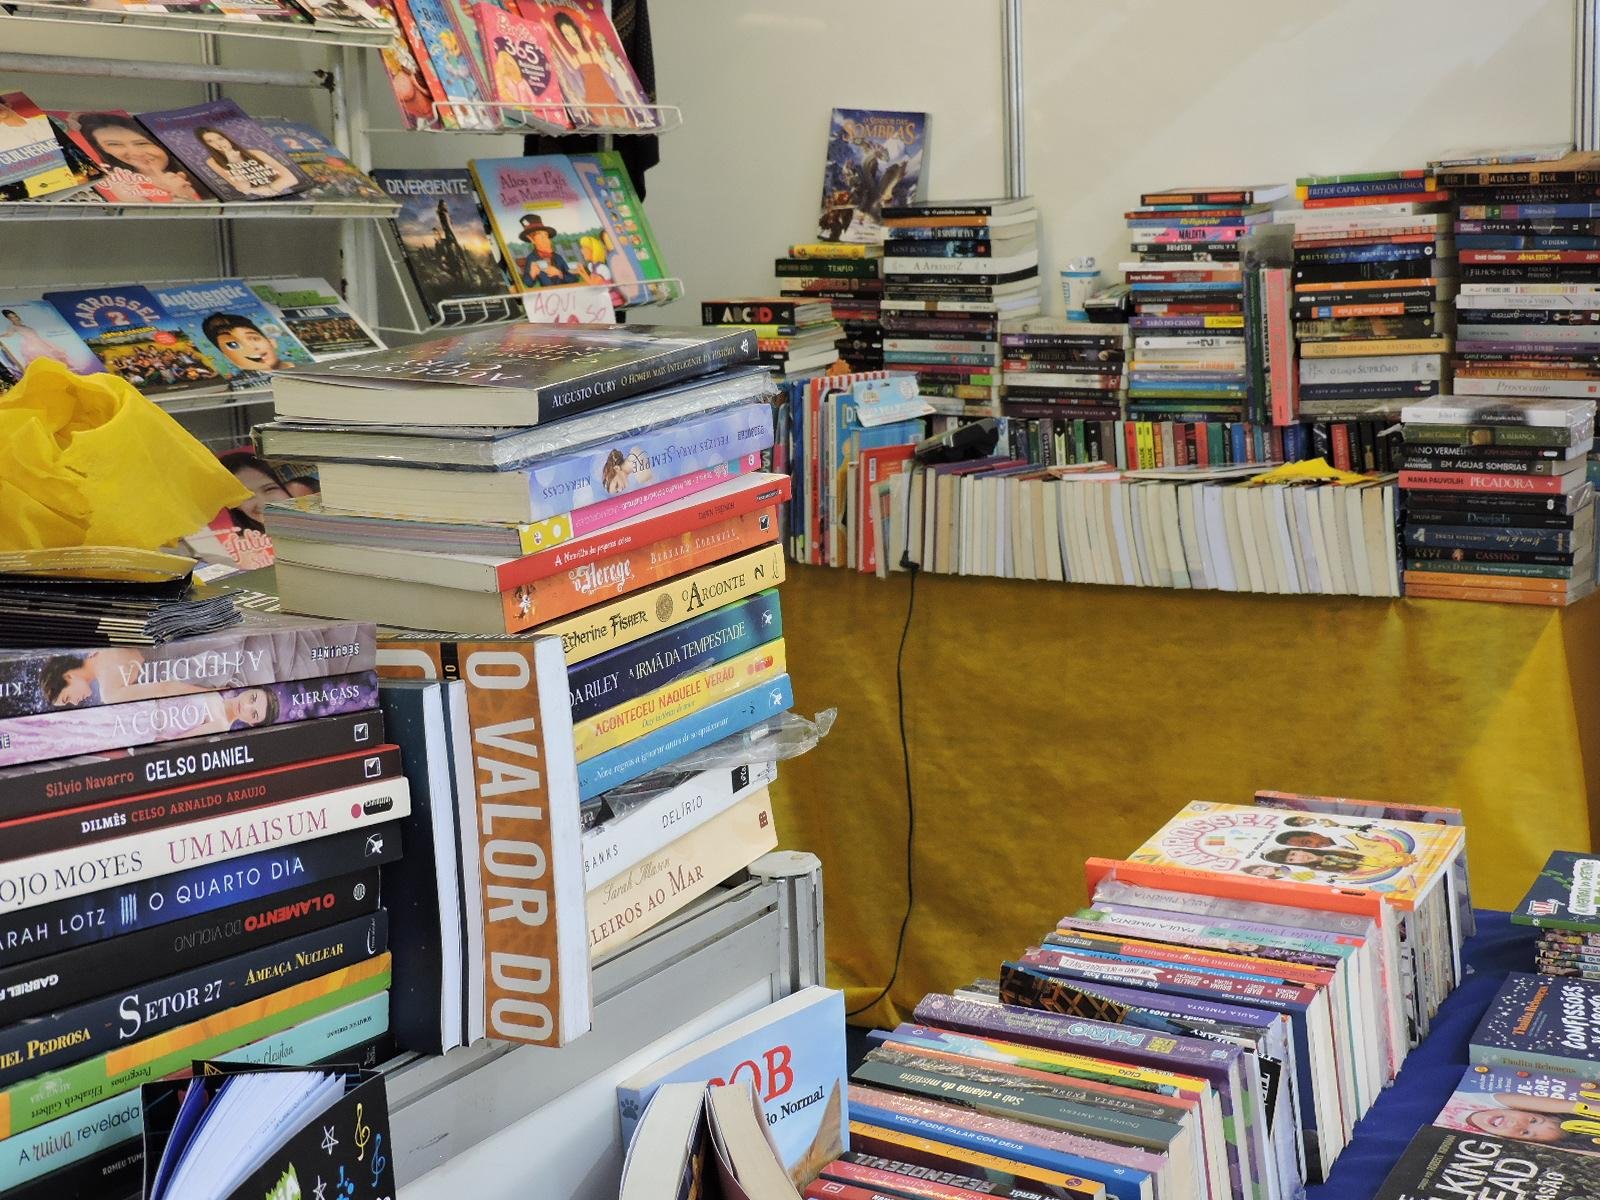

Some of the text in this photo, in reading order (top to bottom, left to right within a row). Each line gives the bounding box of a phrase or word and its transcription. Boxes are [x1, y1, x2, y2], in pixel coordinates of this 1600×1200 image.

[842, 117, 917, 146] SOMBRAS
[385, 178, 470, 197] DIVERGENTE
[1178, 229, 1206, 239] MALDITA
[80, 294, 161, 330] CARROSSEL
[108, 311, 130, 327] 2
[534, 291, 577, 316] AQUI
[551, 387, 592, 409] AUGUSTO
[593, 379, 617, 397] CURY
[631, 443, 678, 474] SEMPRE
[676, 443, 698, 459] PARA
[699, 434, 730, 453] FELIZES
[1456, 459, 1484, 470] ÁGUAS
[1486, 461, 1527, 472] SOMBRIAS
[1470, 476, 1535, 489] PECADORA
[608, 606, 649, 638] FISHER
[686, 574, 746, 613] ARCONTE
[584, 674, 621, 702] RILEY
[635, 651, 664, 680] IRMÃ
[680, 621, 746, 659] TEMPESTADE
[594, 665, 736, 738] ACONTECEU NAQUELE VERÃO
[129, 702, 215, 737] COROA
[45, 744, 255, 799] Silvio Navarro CELSO DANIEL
[80, 784, 267, 835] DILMÊS CELSO ARNALDO ARAUJO
[472, 717, 550, 929] VALOR
[661, 794, 704, 829] DELÍRIO
[53, 807, 329, 893] MOYES UM MAIS UM
[584, 843, 620, 874] BANKS
[59, 855, 306, 936] LOTZ O QUARTO DIA
[588, 863, 705, 948] LEIROS AO MAR
[243, 895, 323, 933] LAMENTO
[1109, 914, 1197, 934] PAULA PIMENTA
[26, 941, 346, 1062] PEDROSA SETOR 27 AMEAÇA NUCLEAR
[489, 951, 554, 1042] DO
[1186, 1003, 1227, 1017] PIMENTA
[1067, 1022, 1147, 1048] DIÁRIO
[1561, 984, 1586, 1052] CONFISSÕES
[31, 1065, 153, 1121] Peregrinos Elizabeth Gilbert
[899, 1070, 942, 1091] mistério
[956, 1083, 993, 1101] chama
[780, 1084, 825, 1121] Normal
[1003, 1094, 1025, 1107] Sob
[32, 1133, 74, 1164] ruiva
[76, 1105, 141, 1144] revelada
[894, 1113, 1024, 1151] VOCÊ PODE FALAR COM DEUS
[102, 1160, 128, 1176] ROMEU
